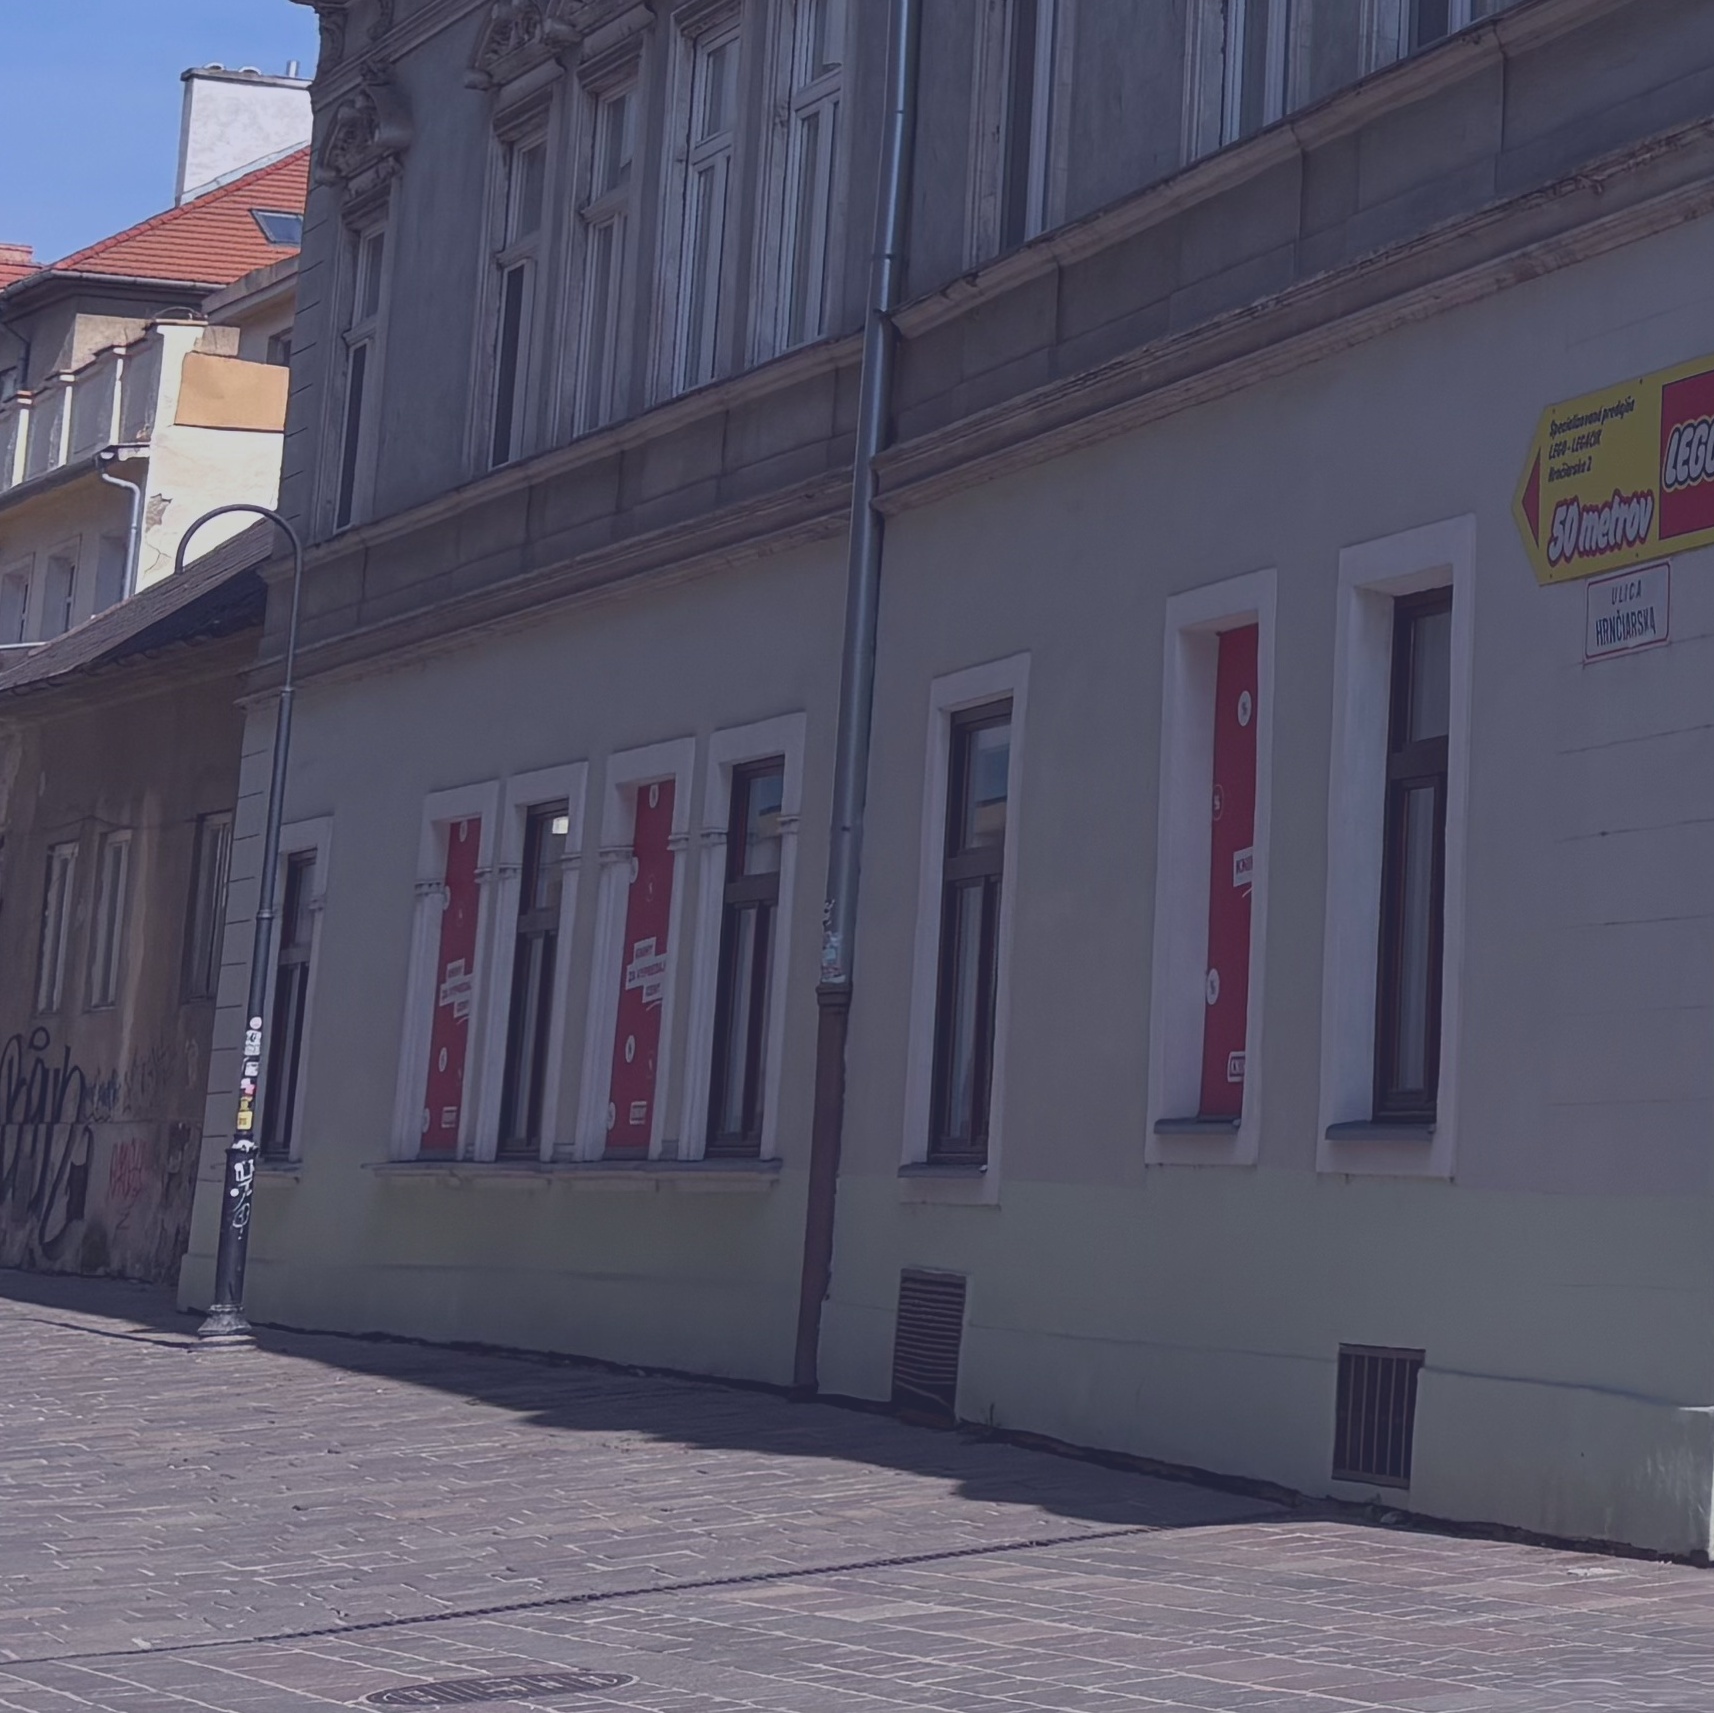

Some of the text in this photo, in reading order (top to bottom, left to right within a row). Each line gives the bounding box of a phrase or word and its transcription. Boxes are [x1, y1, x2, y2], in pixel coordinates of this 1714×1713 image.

[1548, 488, 1654, 566] 50 metrov
[1611, 579, 1642, 606] ULICA
[1596, 606, 1656, 647] HRNČIARSKA
